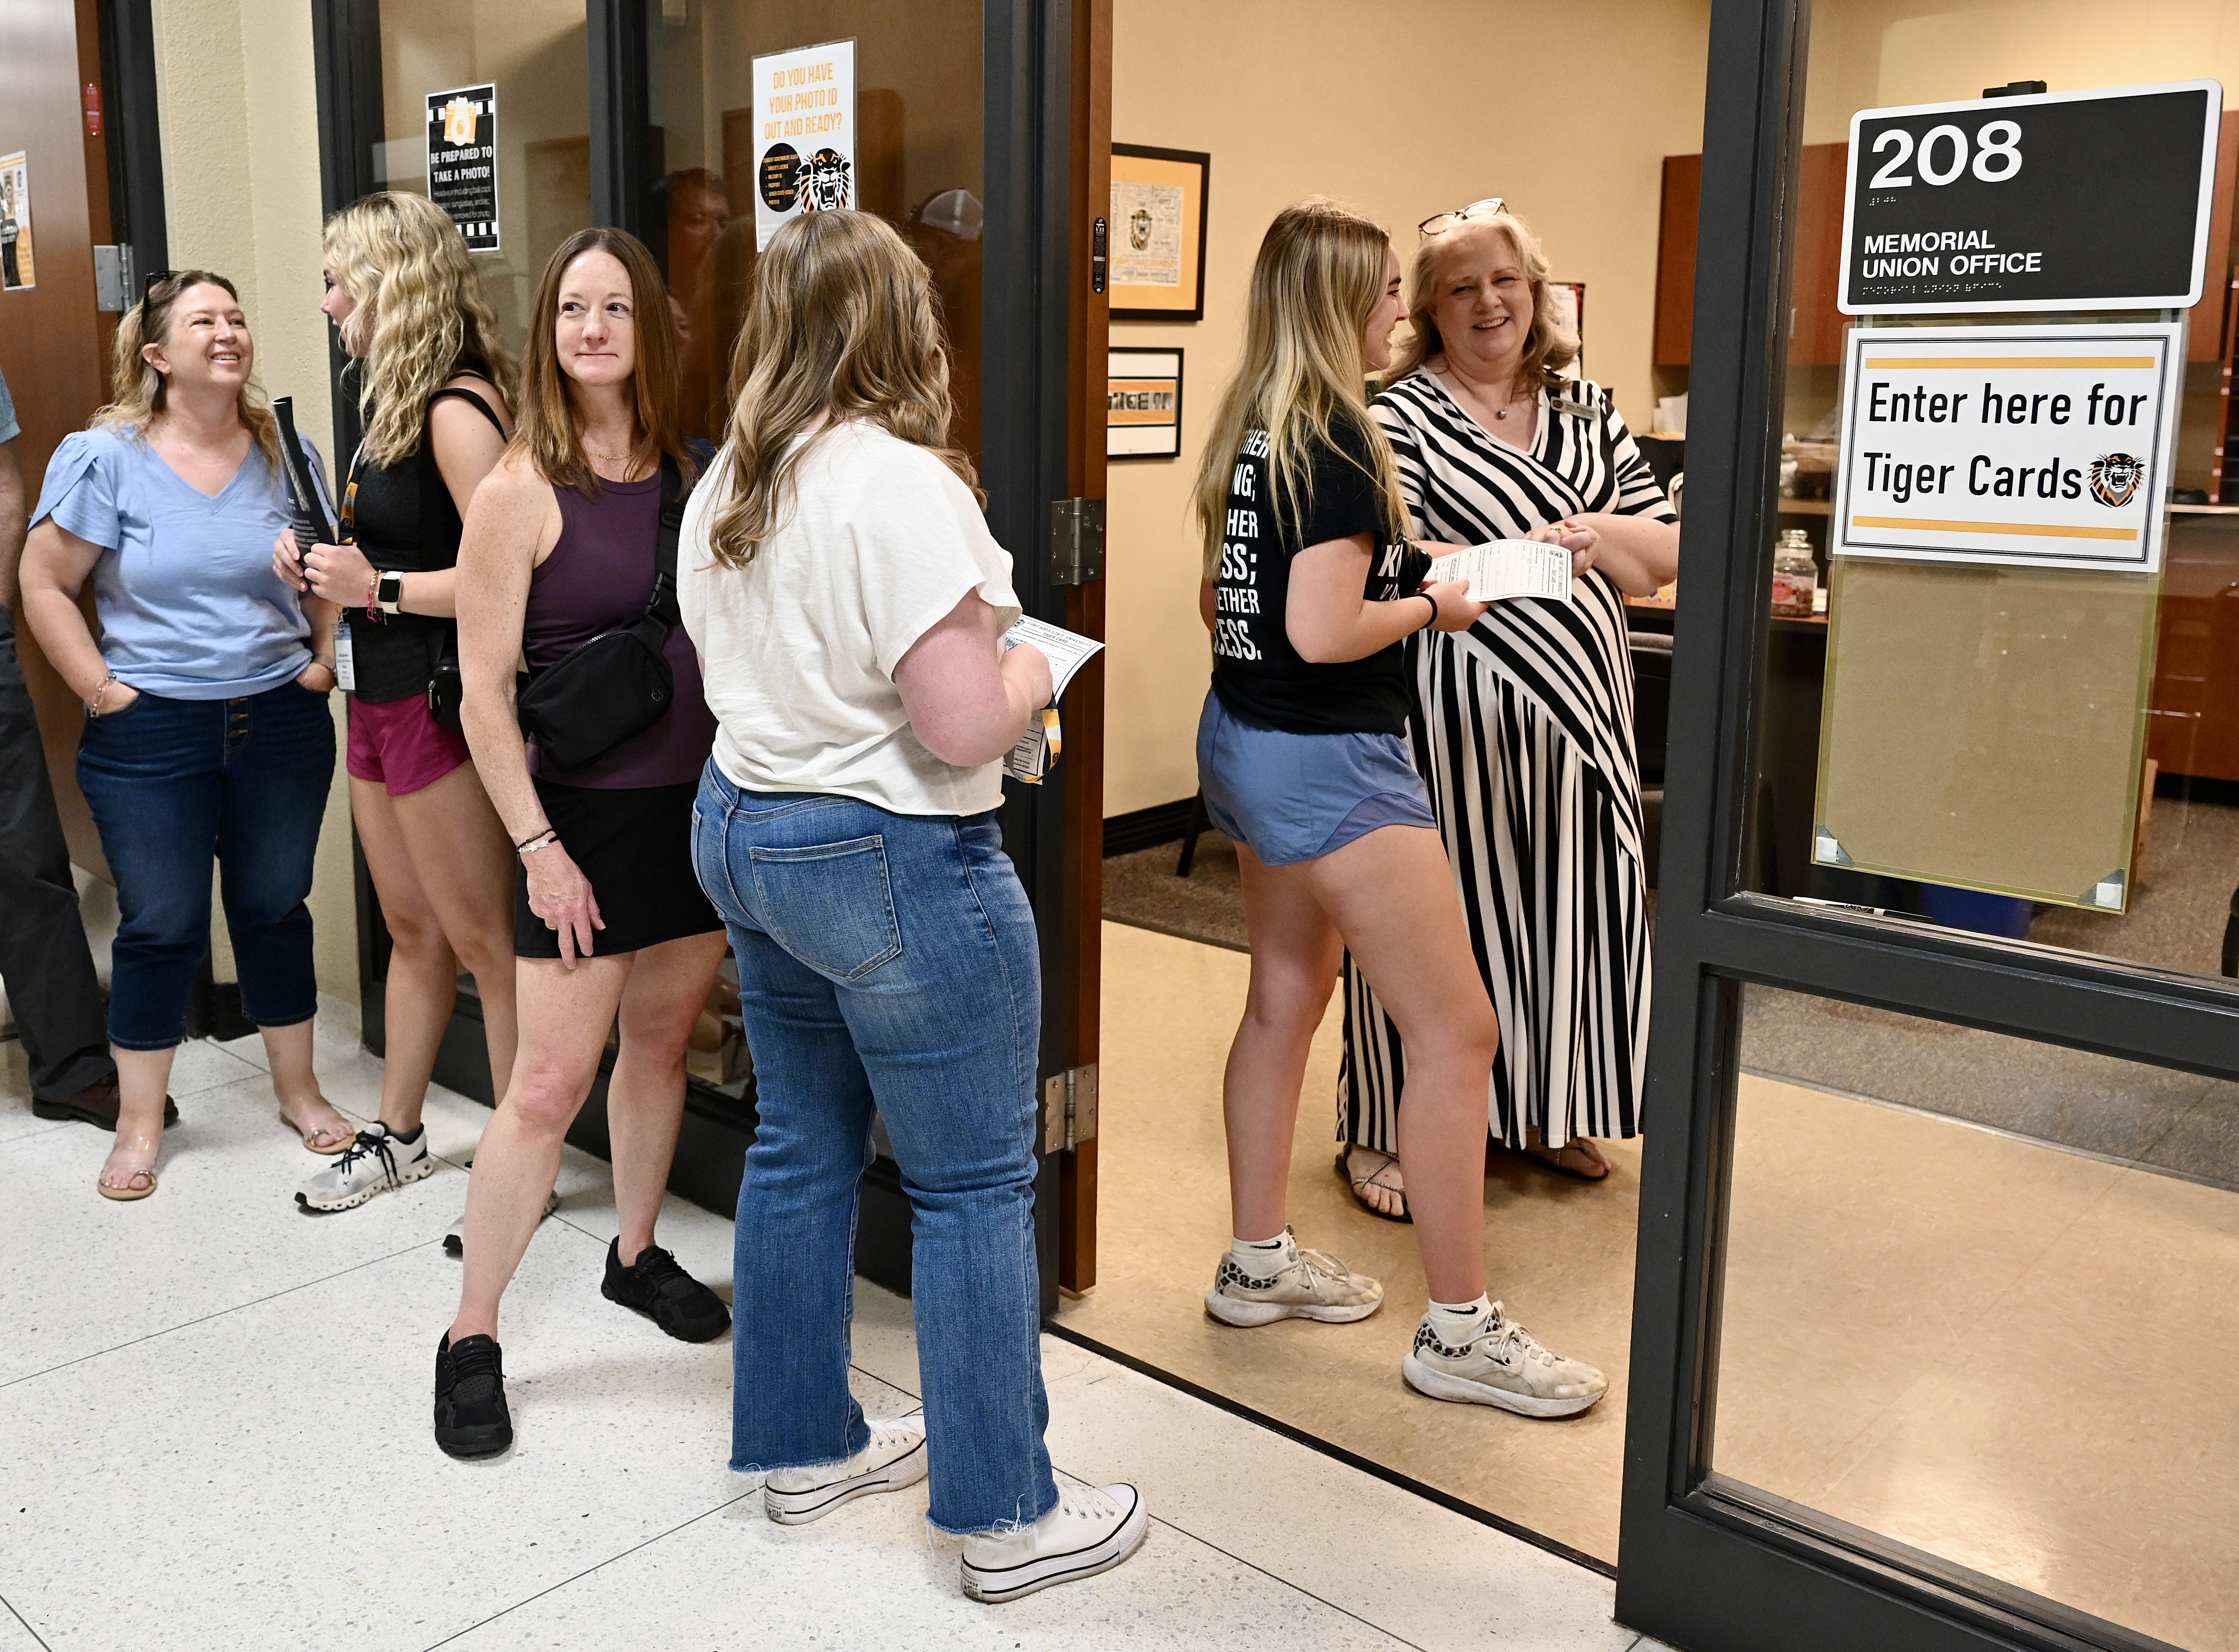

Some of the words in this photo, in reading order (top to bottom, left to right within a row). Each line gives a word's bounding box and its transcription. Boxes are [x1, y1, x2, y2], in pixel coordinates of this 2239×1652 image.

[774, 71, 785, 89] DO
[788, 68, 806, 86] YOU
[808, 62, 834, 82] HAVE
[769, 94, 792, 114] YOUR
[795, 89, 825, 111] PHOTO
[828, 87, 838, 105] ID
[765, 121, 782, 140] OUT
[784, 118, 803, 137] AND
[806, 112, 842, 134] READY?
[430, 151, 439, 164] BE
[441, 147, 479, 163] PREPARED
[481, 146, 492, 158] TO
[1869, 120, 2023, 189] 208
[433, 169, 452, 183] TAKE
[454, 170, 459, 181] A
[461, 166, 490, 180] PHOTO!
[1864, 230, 1995, 254] MEMORIAL
[1863, 257, 1939, 278] UNION
[1950, 253, 2042, 275] OFFICE
[1869, 382, 1968, 423] Enter
[1982, 383, 2071, 425] here
[2088, 383, 2148, 426] for
[1231, 463, 1256, 502] NG;
[1864, 452, 1954, 504] Tiger
[1968, 455, 2082, 500] Cards
[1227, 509, 1258, 538] HER
[1222, 542, 1257, 585] SS;
[1065, 636, 1092, 647] UNIVERSITY
